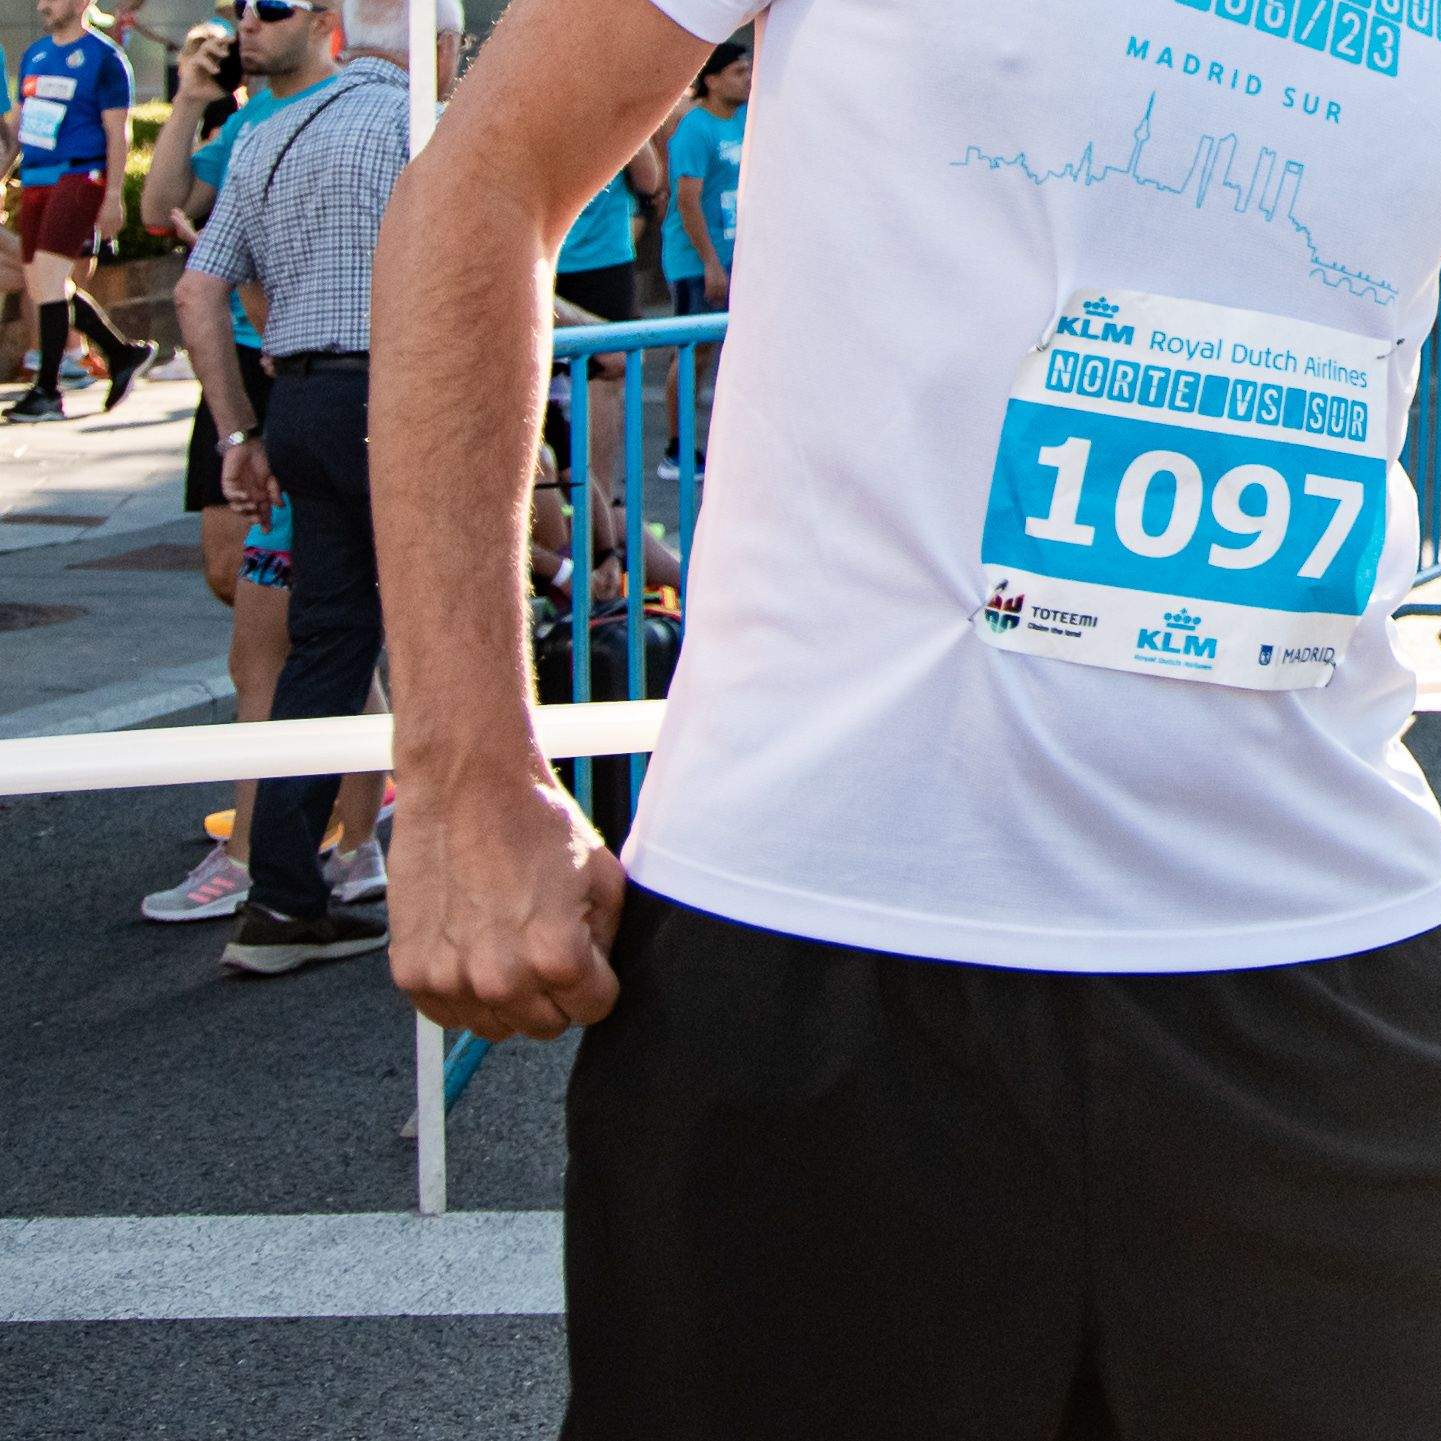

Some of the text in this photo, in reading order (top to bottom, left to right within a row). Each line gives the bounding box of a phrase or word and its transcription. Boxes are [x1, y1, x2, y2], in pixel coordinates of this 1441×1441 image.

[1126, 35, 1342, 123] MADRID SUR
[1056, 316, 1369, 388] KLM Royal Dutch Airlines
[1048, 351, 1367, 440] NORTE VS SUR
[1024, 436, 1364, 580] 1097
[1031, 606, 1098, 627] TOTEEMI
[1136, 628, 1218, 659] KLM
[1282, 647, 1335, 665] MADRID
